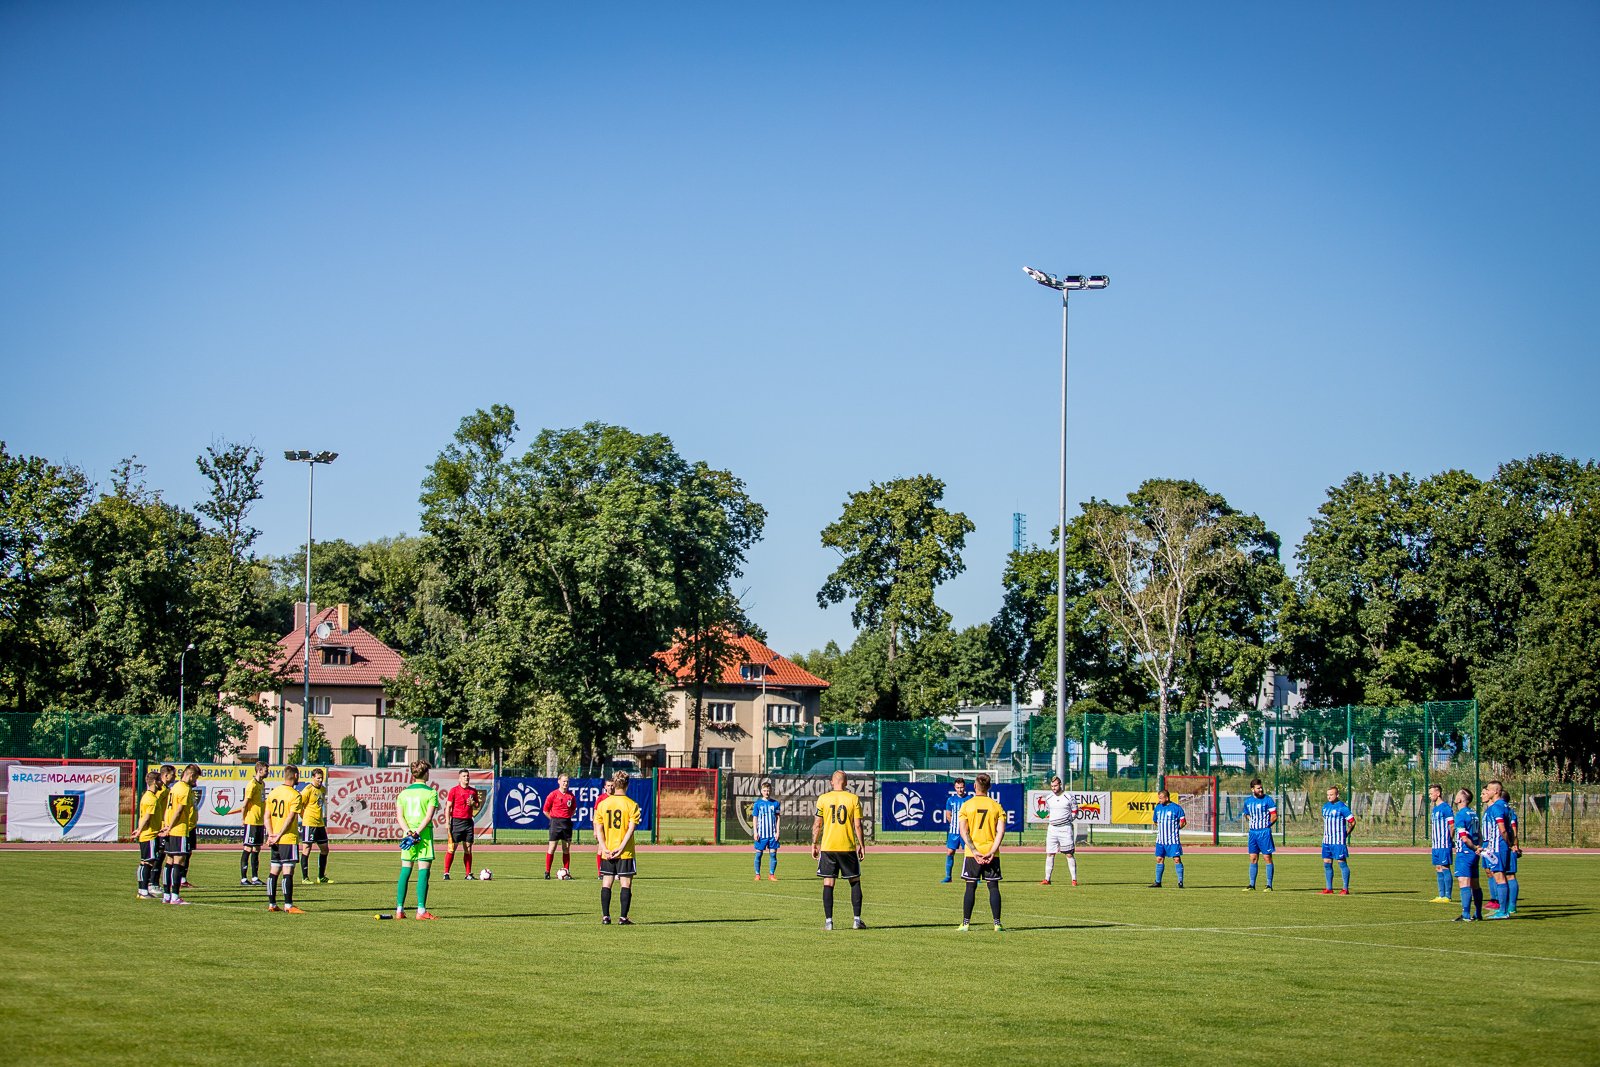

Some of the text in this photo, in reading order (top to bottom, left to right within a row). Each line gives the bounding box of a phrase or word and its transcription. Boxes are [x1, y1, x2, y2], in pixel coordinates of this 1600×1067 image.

[12, 773, 117, 784] #RAZEMDLAMARYSI
[775, 778, 874, 797] KARKONSZE
[568, 787, 607, 802] TER
[1074, 794, 1100, 805] ENIA
[271, 798, 285, 819] 20
[405, 796, 421, 817] 12
[829, 804, 848, 826] 10
[1127, 801, 1157, 811] NETT
[330, 810, 405, 839] alternato
[605, 809, 622, 830] 18
[976, 808, 989, 830] 7
